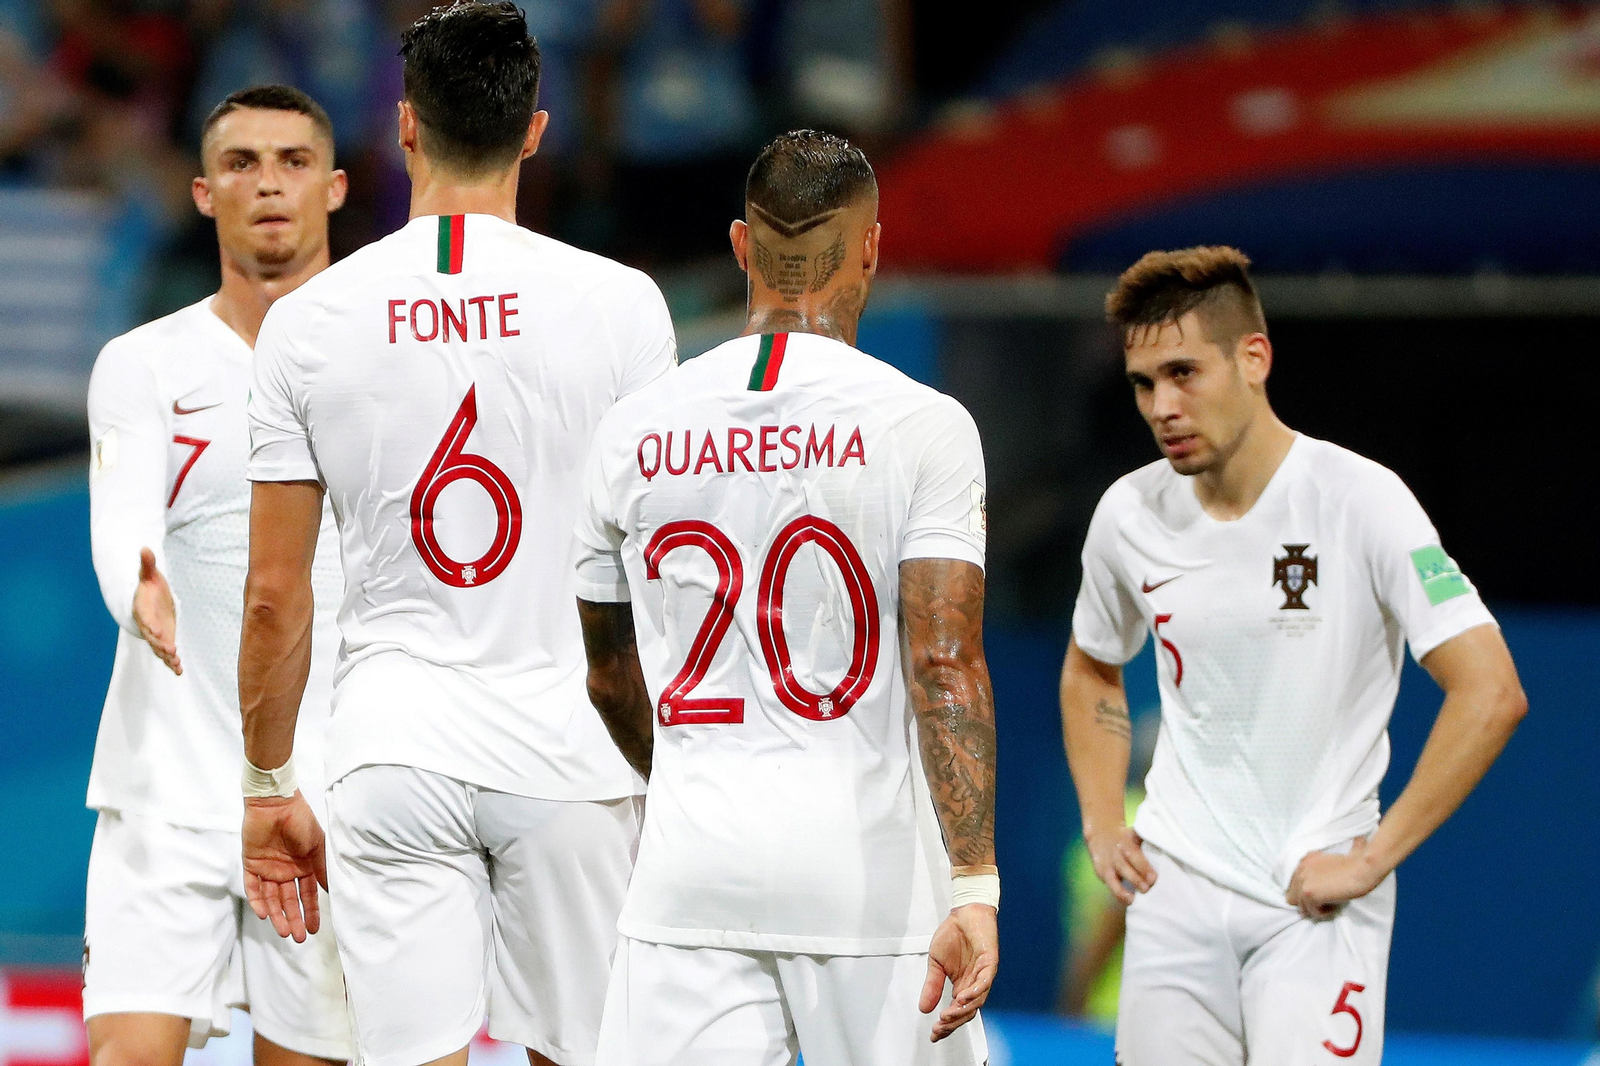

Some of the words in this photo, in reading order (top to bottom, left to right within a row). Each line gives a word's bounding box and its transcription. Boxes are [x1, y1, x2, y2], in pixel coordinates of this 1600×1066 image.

[388, 292, 520, 344] FONTE
[168, 434, 211, 508] 7
[410, 384, 523, 589] 6
[637, 425, 866, 481] QUARESMA
[644, 514, 880, 727] 20
[1154, 614, 1183, 688] 5
[1322, 981, 1366, 1059] 5
